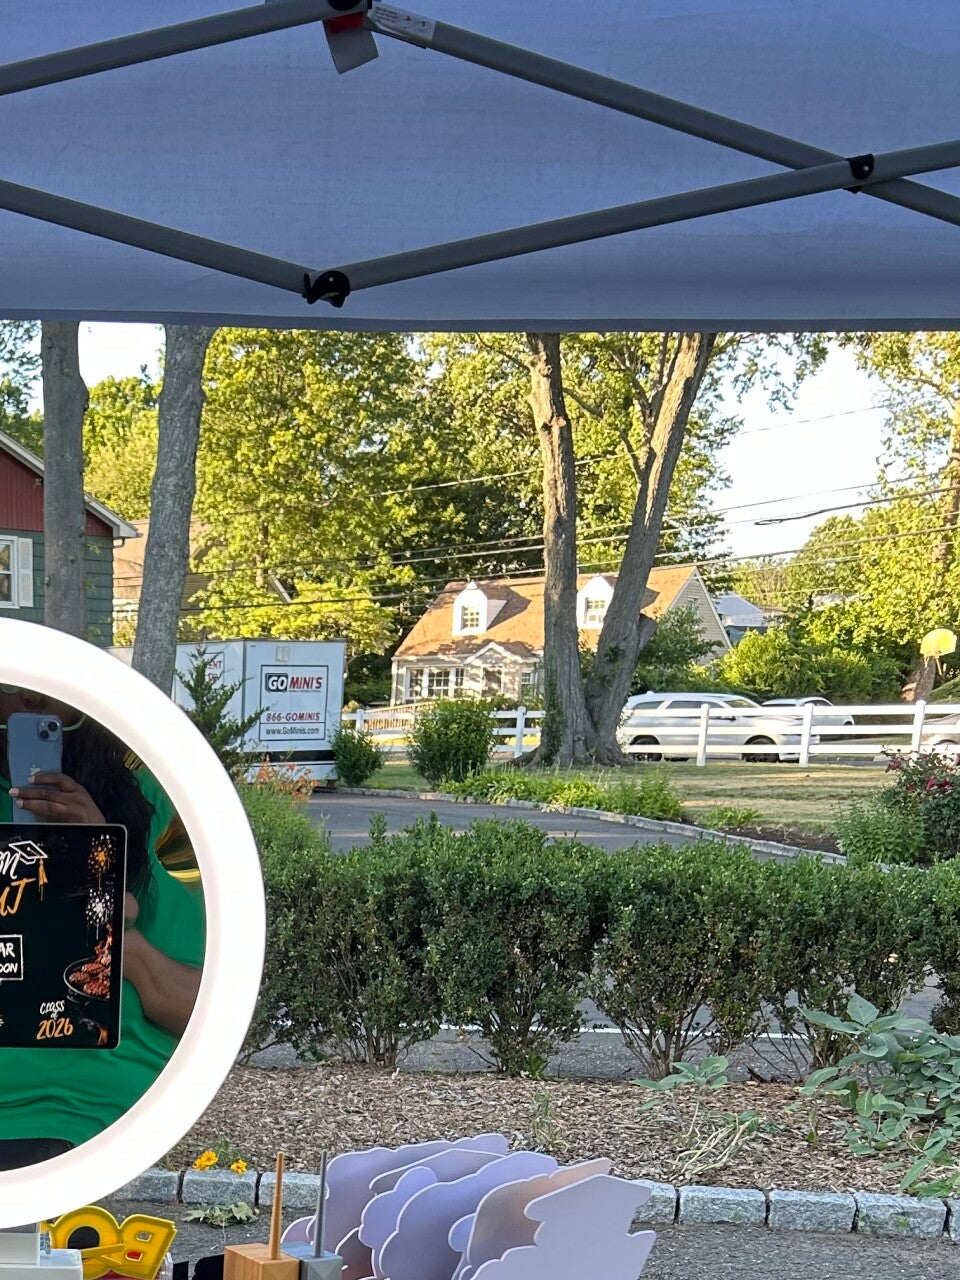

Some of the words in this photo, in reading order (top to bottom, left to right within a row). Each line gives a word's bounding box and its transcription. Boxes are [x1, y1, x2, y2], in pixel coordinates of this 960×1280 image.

[268, 676, 288, 690] GO
[289, 676, 323, 690] MINI'S
[266, 712, 320, 721] 866-GOMINIS
[36, 1017, 74, 1040] 2026
